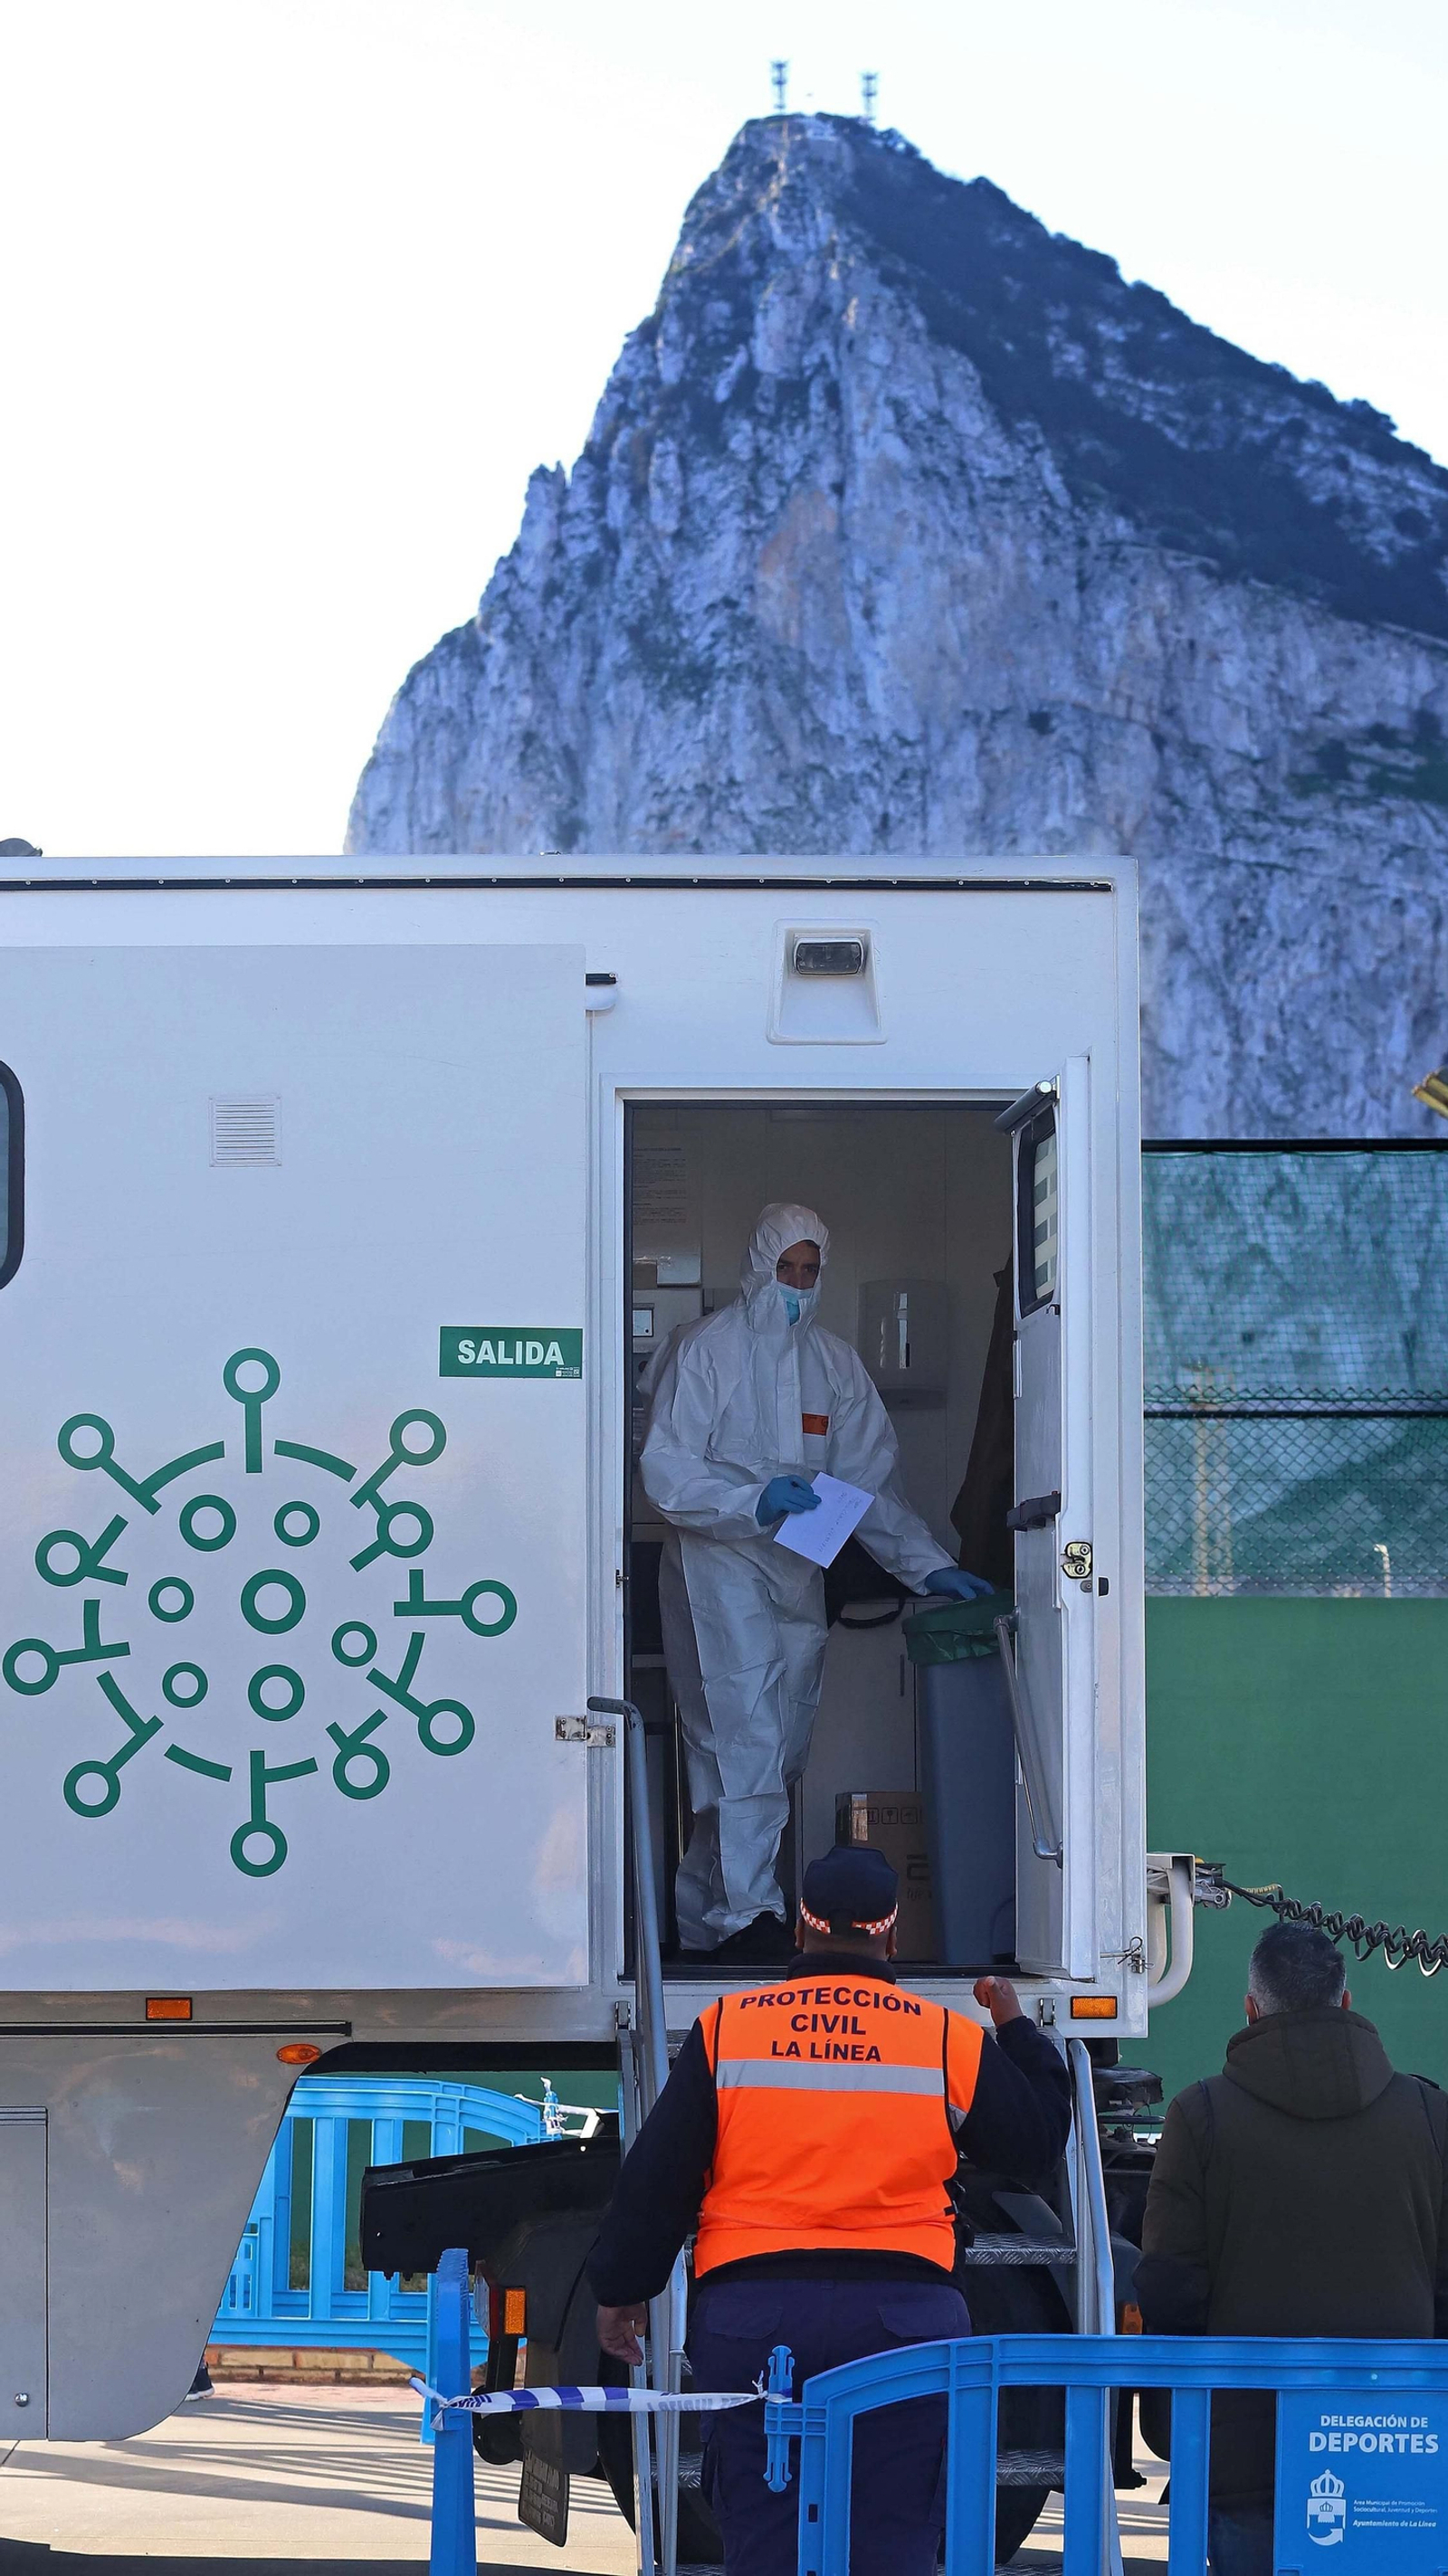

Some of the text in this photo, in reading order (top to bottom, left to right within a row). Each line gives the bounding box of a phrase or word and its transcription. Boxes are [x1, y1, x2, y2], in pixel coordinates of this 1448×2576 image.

[457, 1339, 565, 1365] SALIDA
[739, 1986, 921, 2016] PROTECCIÓN
[790, 2013, 867, 2036] CIVIL
[771, 2039, 881, 2062] LA LÍNEA
[1320, 2414, 1429, 2429] DELEGACIÓN DE
[1309, 2431, 1439, 2454] DEPORTES
[1352, 2519, 1399, 2528] Ayuntamiento
[1400, 2520, 1409, 2528] de
[1409, 2520, 1417, 2528] La
